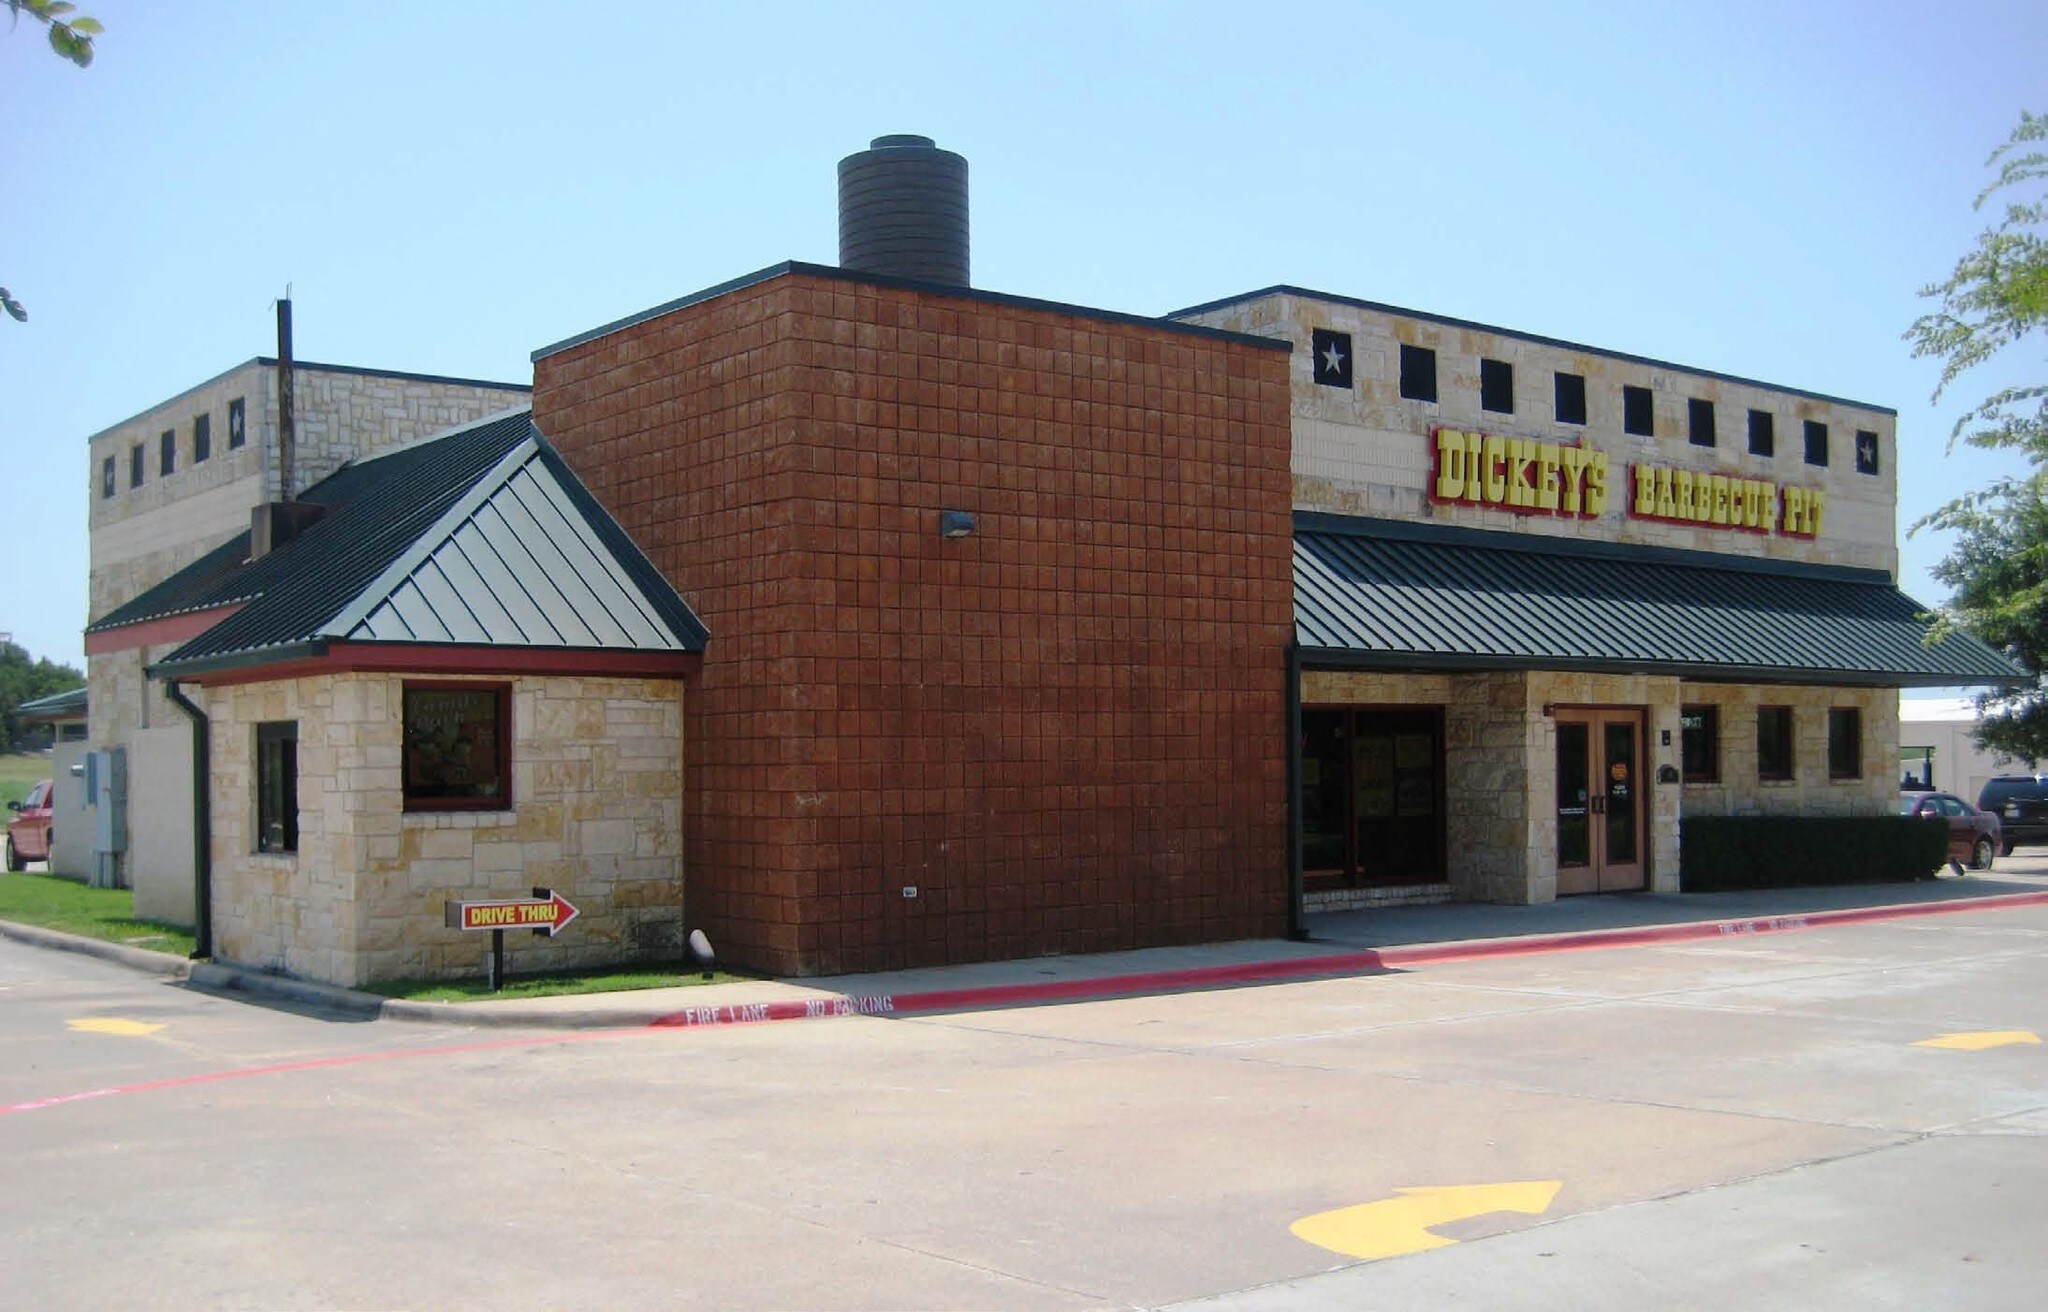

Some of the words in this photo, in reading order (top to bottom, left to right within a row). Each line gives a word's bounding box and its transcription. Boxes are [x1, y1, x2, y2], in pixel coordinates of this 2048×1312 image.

[1437, 428, 1608, 516] DICKEY'S
[1635, 463, 1777, 531] BARBECUE
[1783, 485, 1826, 536] PIT
[471, 905, 515, 925] DRIVE
[518, 903, 559, 922] THRU
[806, 998, 825, 1017] NO
